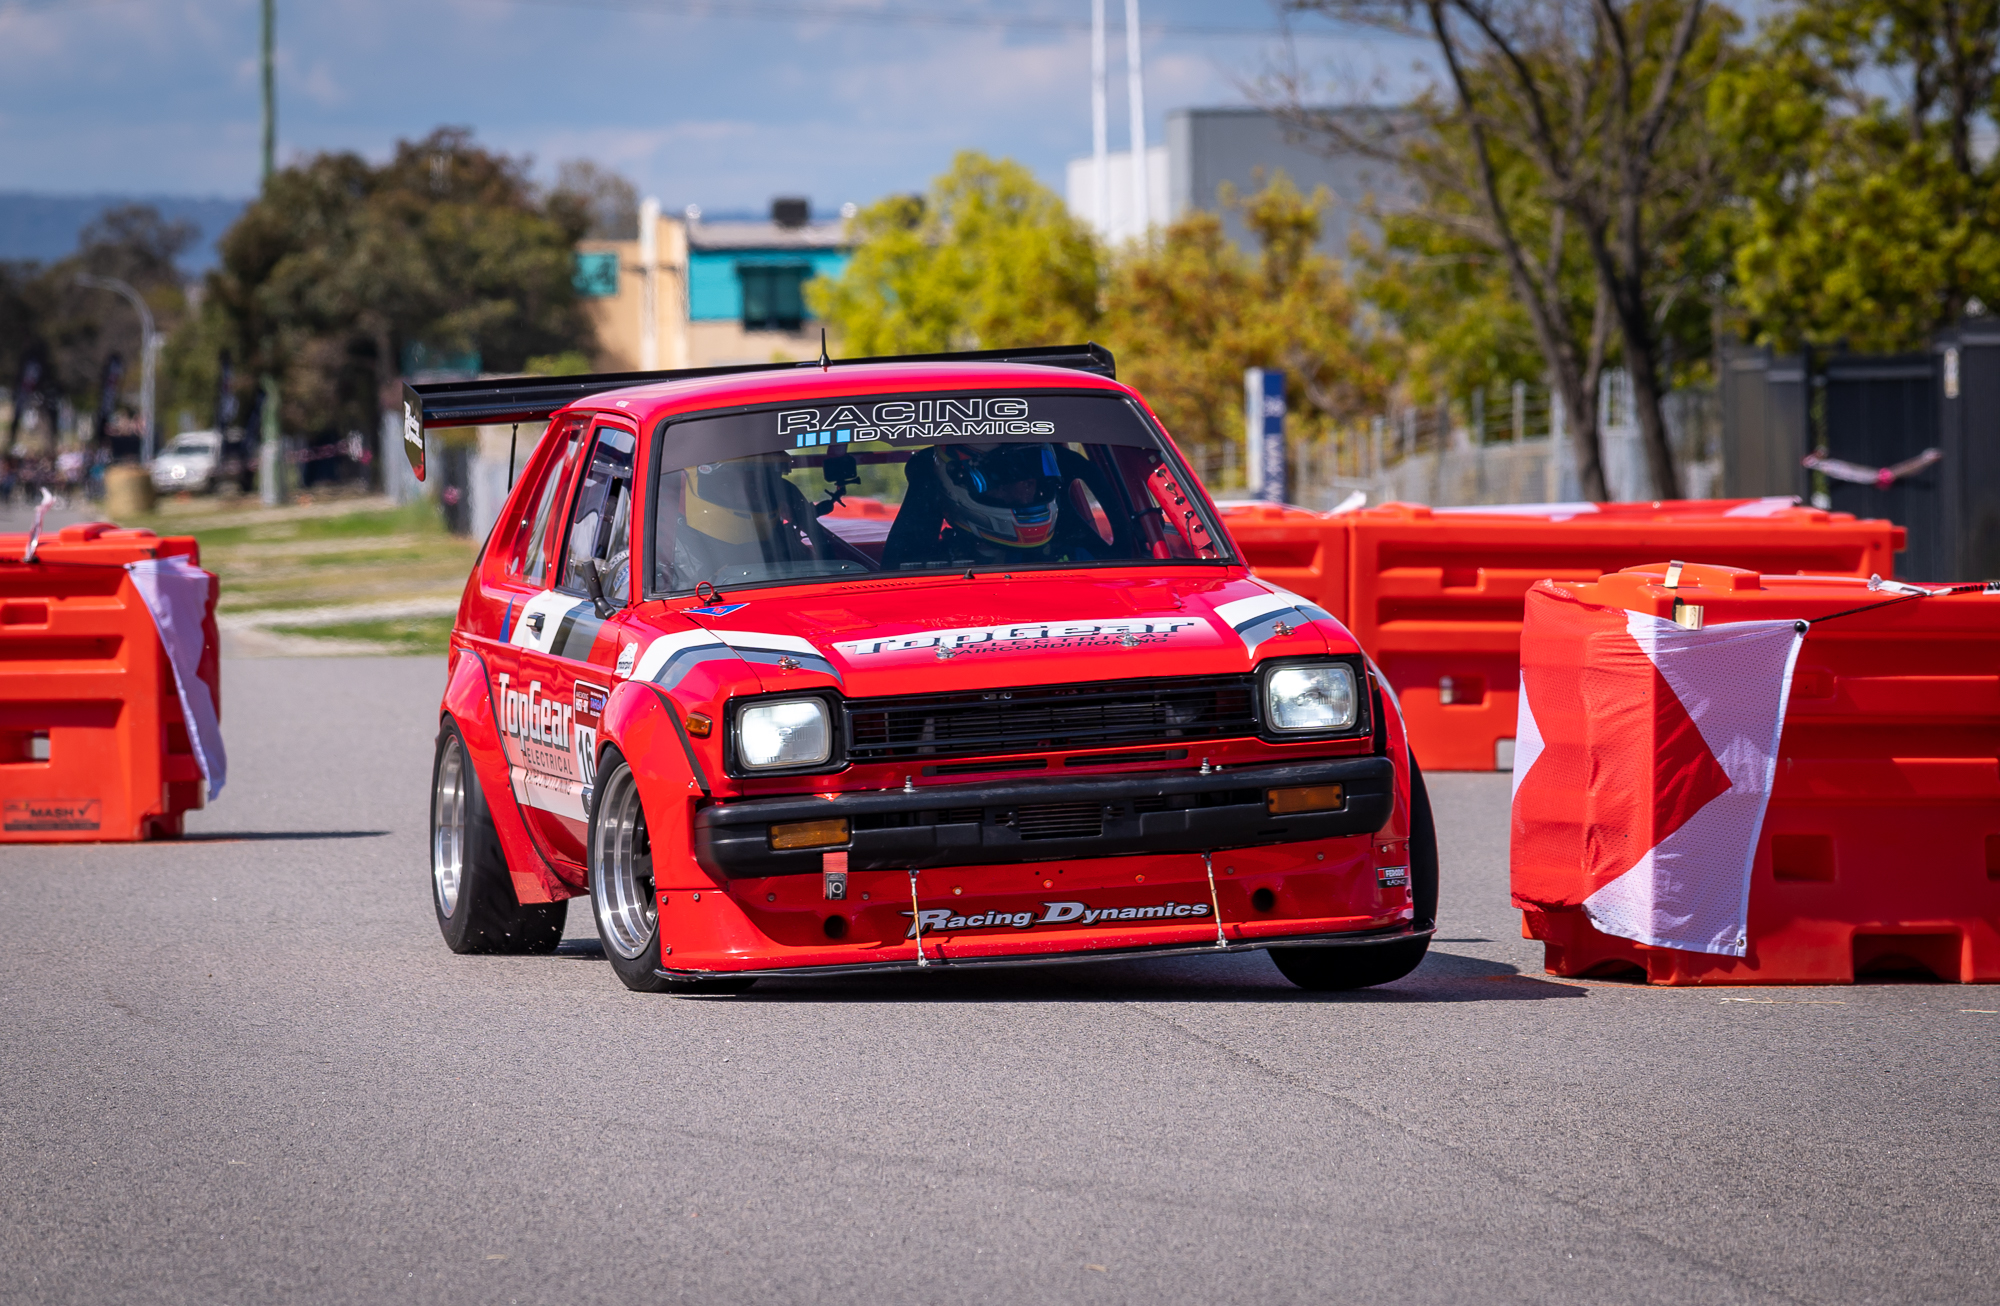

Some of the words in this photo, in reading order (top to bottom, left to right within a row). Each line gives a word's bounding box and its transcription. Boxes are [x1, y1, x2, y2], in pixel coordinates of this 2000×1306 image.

[778, 398, 1029, 435] RACING
[853, 420, 1056, 442] DYNAMICS
[842, 622, 1195, 655] TopGear
[498, 671, 572, 758] TopGear
[526, 747, 573, 776] ELECTRICAL
[30, 808, 74, 817] MASH
[900, 909, 1032, 939] Racing
[1034, 901, 1209, 926] Dynamics
